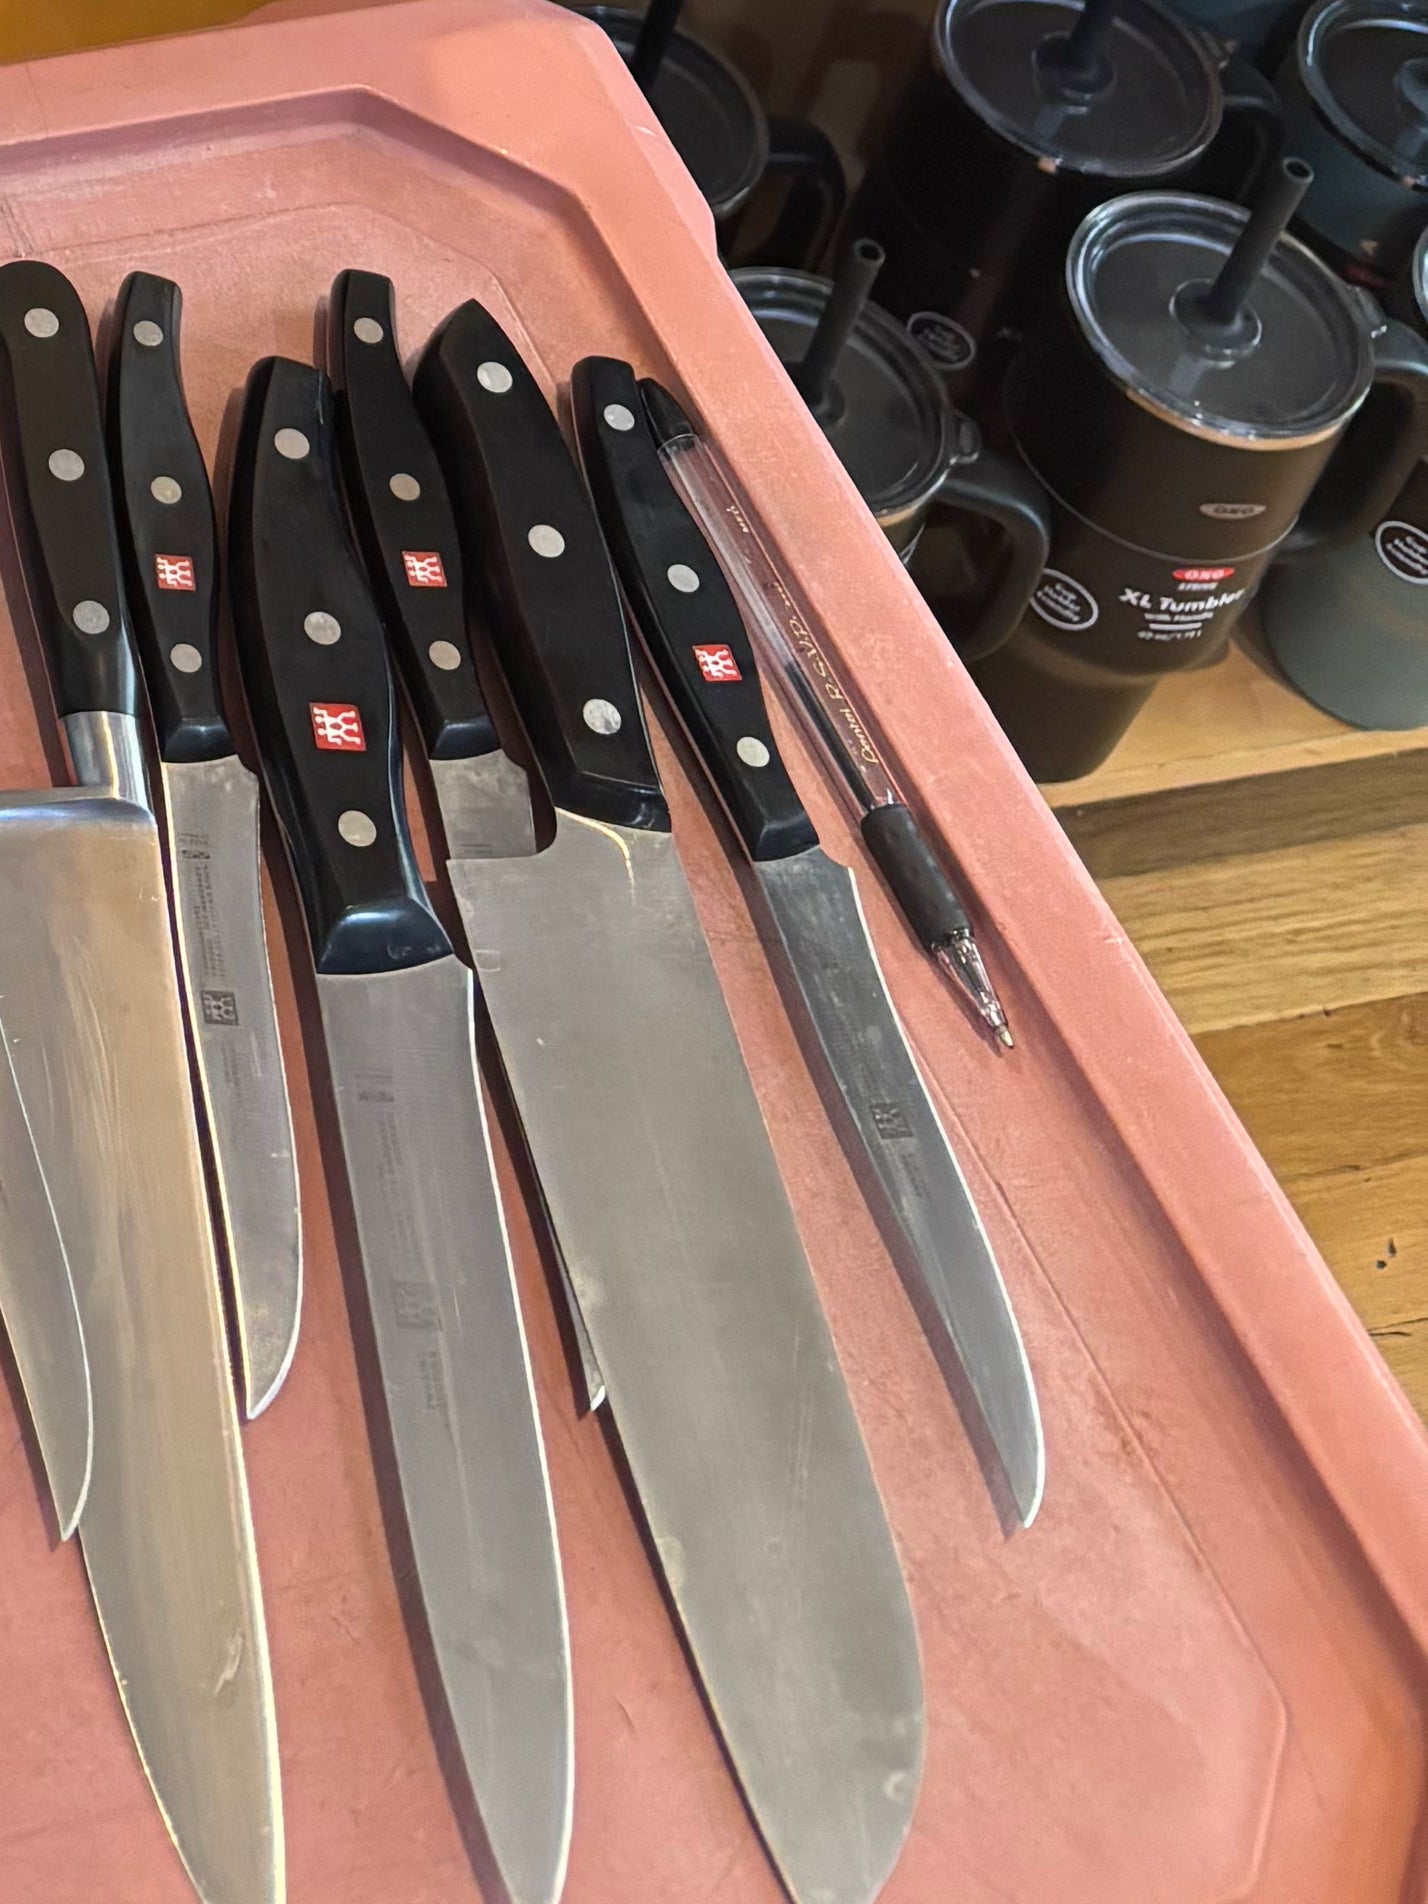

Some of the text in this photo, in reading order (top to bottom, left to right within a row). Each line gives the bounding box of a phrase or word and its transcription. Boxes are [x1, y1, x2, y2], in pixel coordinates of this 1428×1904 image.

[1184, 568, 1226, 580] OXO
[1119, 588, 1245, 612] XL Tumbler
